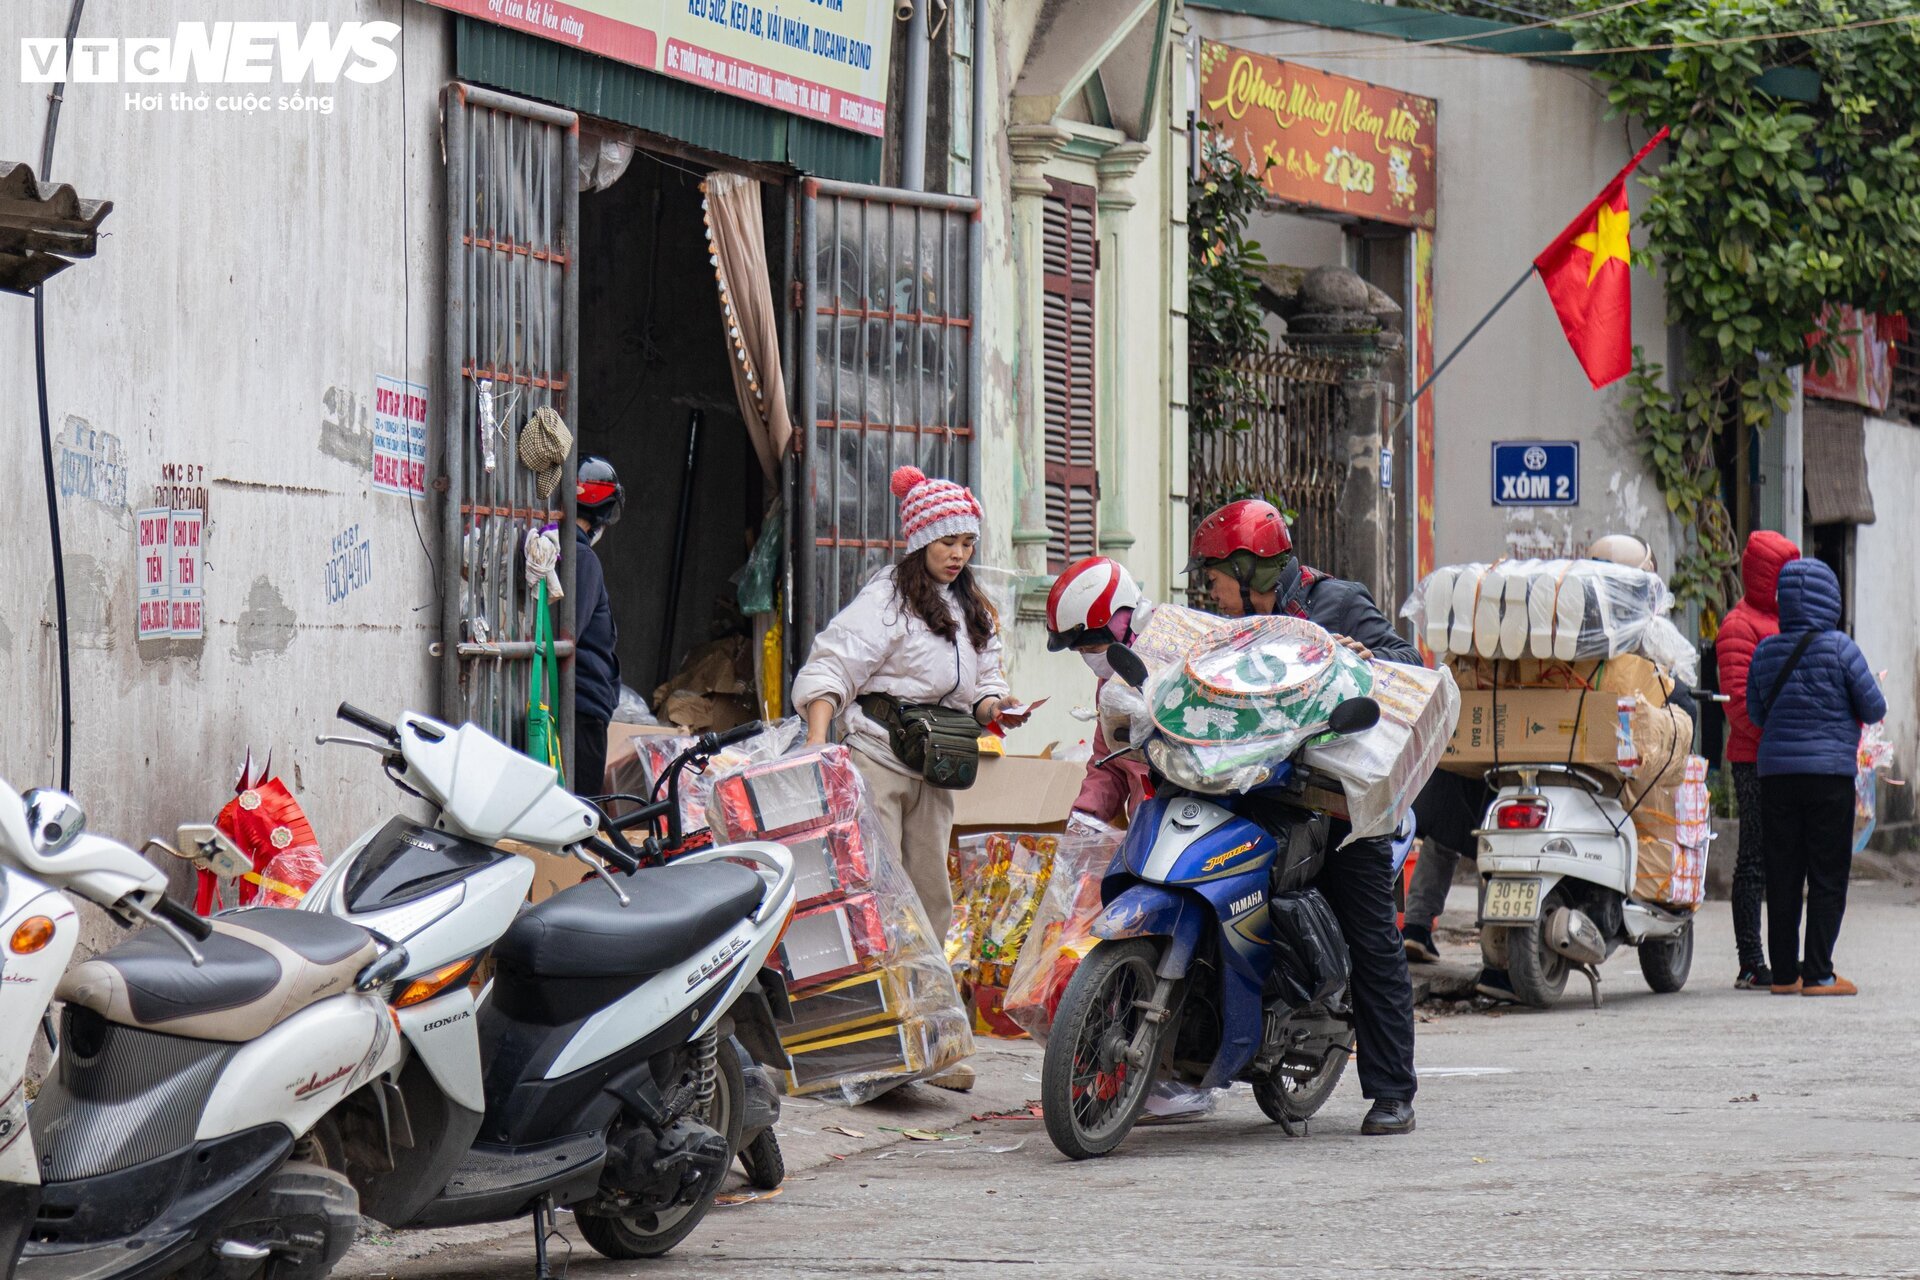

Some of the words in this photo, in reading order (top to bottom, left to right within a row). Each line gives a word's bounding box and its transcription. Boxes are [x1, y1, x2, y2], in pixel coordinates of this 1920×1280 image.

[730, 2, 748, 32] KEO
[849, 39, 872, 71] BOND
[1208, 56, 1294, 129] Chúc
[1286, 78, 1338, 137] Mừng
[1335, 87, 1389, 154] Năm
[1323, 150, 1376, 195] 2023
[1502, 471, 1550, 499] XÓM
[1556, 475, 1570, 499] 2
[140, 519, 154, 547] CHO
[155, 517, 168, 545] VAY
[174, 520, 187, 547] CHO
[188, 520, 201, 547] VAY
[1472, 706, 1483, 725] 500
[1471, 728, 1482, 748] BAO
[400, 833, 436, 852] HONDA
[1230, 889, 1263, 916] YAMAHA
[1494, 882, 1535, 899] 30-F6
[1491, 900, 1533, 918] 5995
[687, 935, 745, 986] CLICK
[423, 1010, 471, 1032] HONDA
